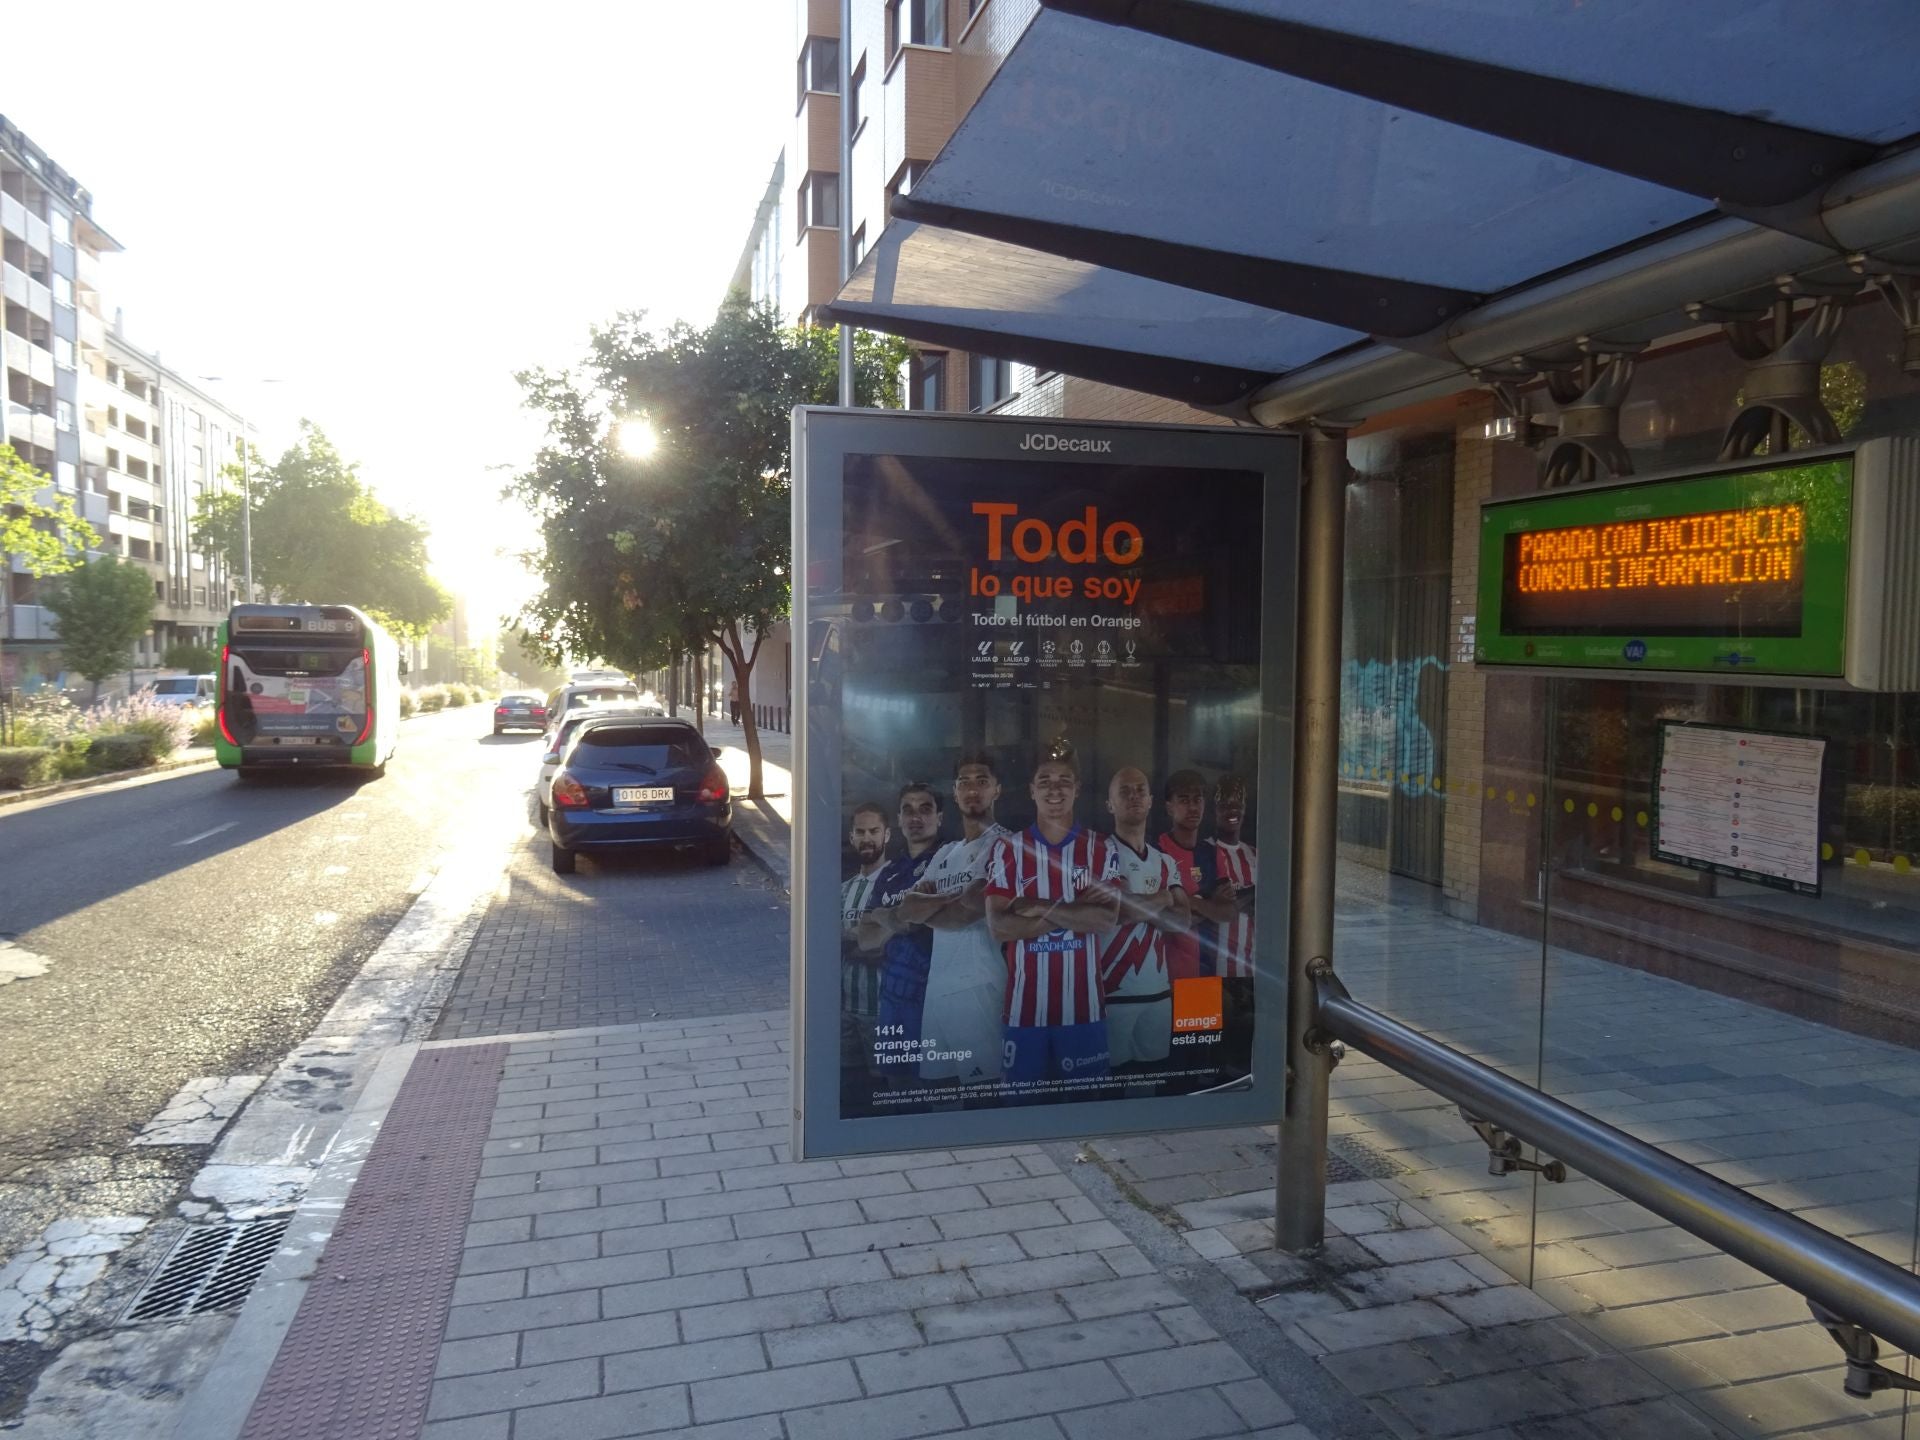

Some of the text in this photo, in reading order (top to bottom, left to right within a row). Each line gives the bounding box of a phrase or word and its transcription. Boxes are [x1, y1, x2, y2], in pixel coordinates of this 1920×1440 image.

[1019, 433, 1112, 453] JCDecaux
[972, 502, 1143, 566] Todo
[1519, 504, 1801, 563] PARADA CON INCIDENCIA
[1518, 546, 1792, 593] CONSULTE INFORMACION
[971, 568, 1142, 606] lo que soy
[308, 621, 354, 632] BUS 9
[971, 613, 1141, 630] Todo el fútbol en Orange
[621, 789, 671, 800] 0106 DRK
[1029, 939, 1082, 952] RIYADH AIR
[1175, 1016, 1217, 1029] orange
[874, 1024, 904, 1037] 1414
[874, 1039, 936, 1051] orange.es
[1172, 1031, 1223, 1045] está aquí
[874, 1049, 973, 1065] Tiendas Orange
[872, 1090, 900, 1098] Consulta
